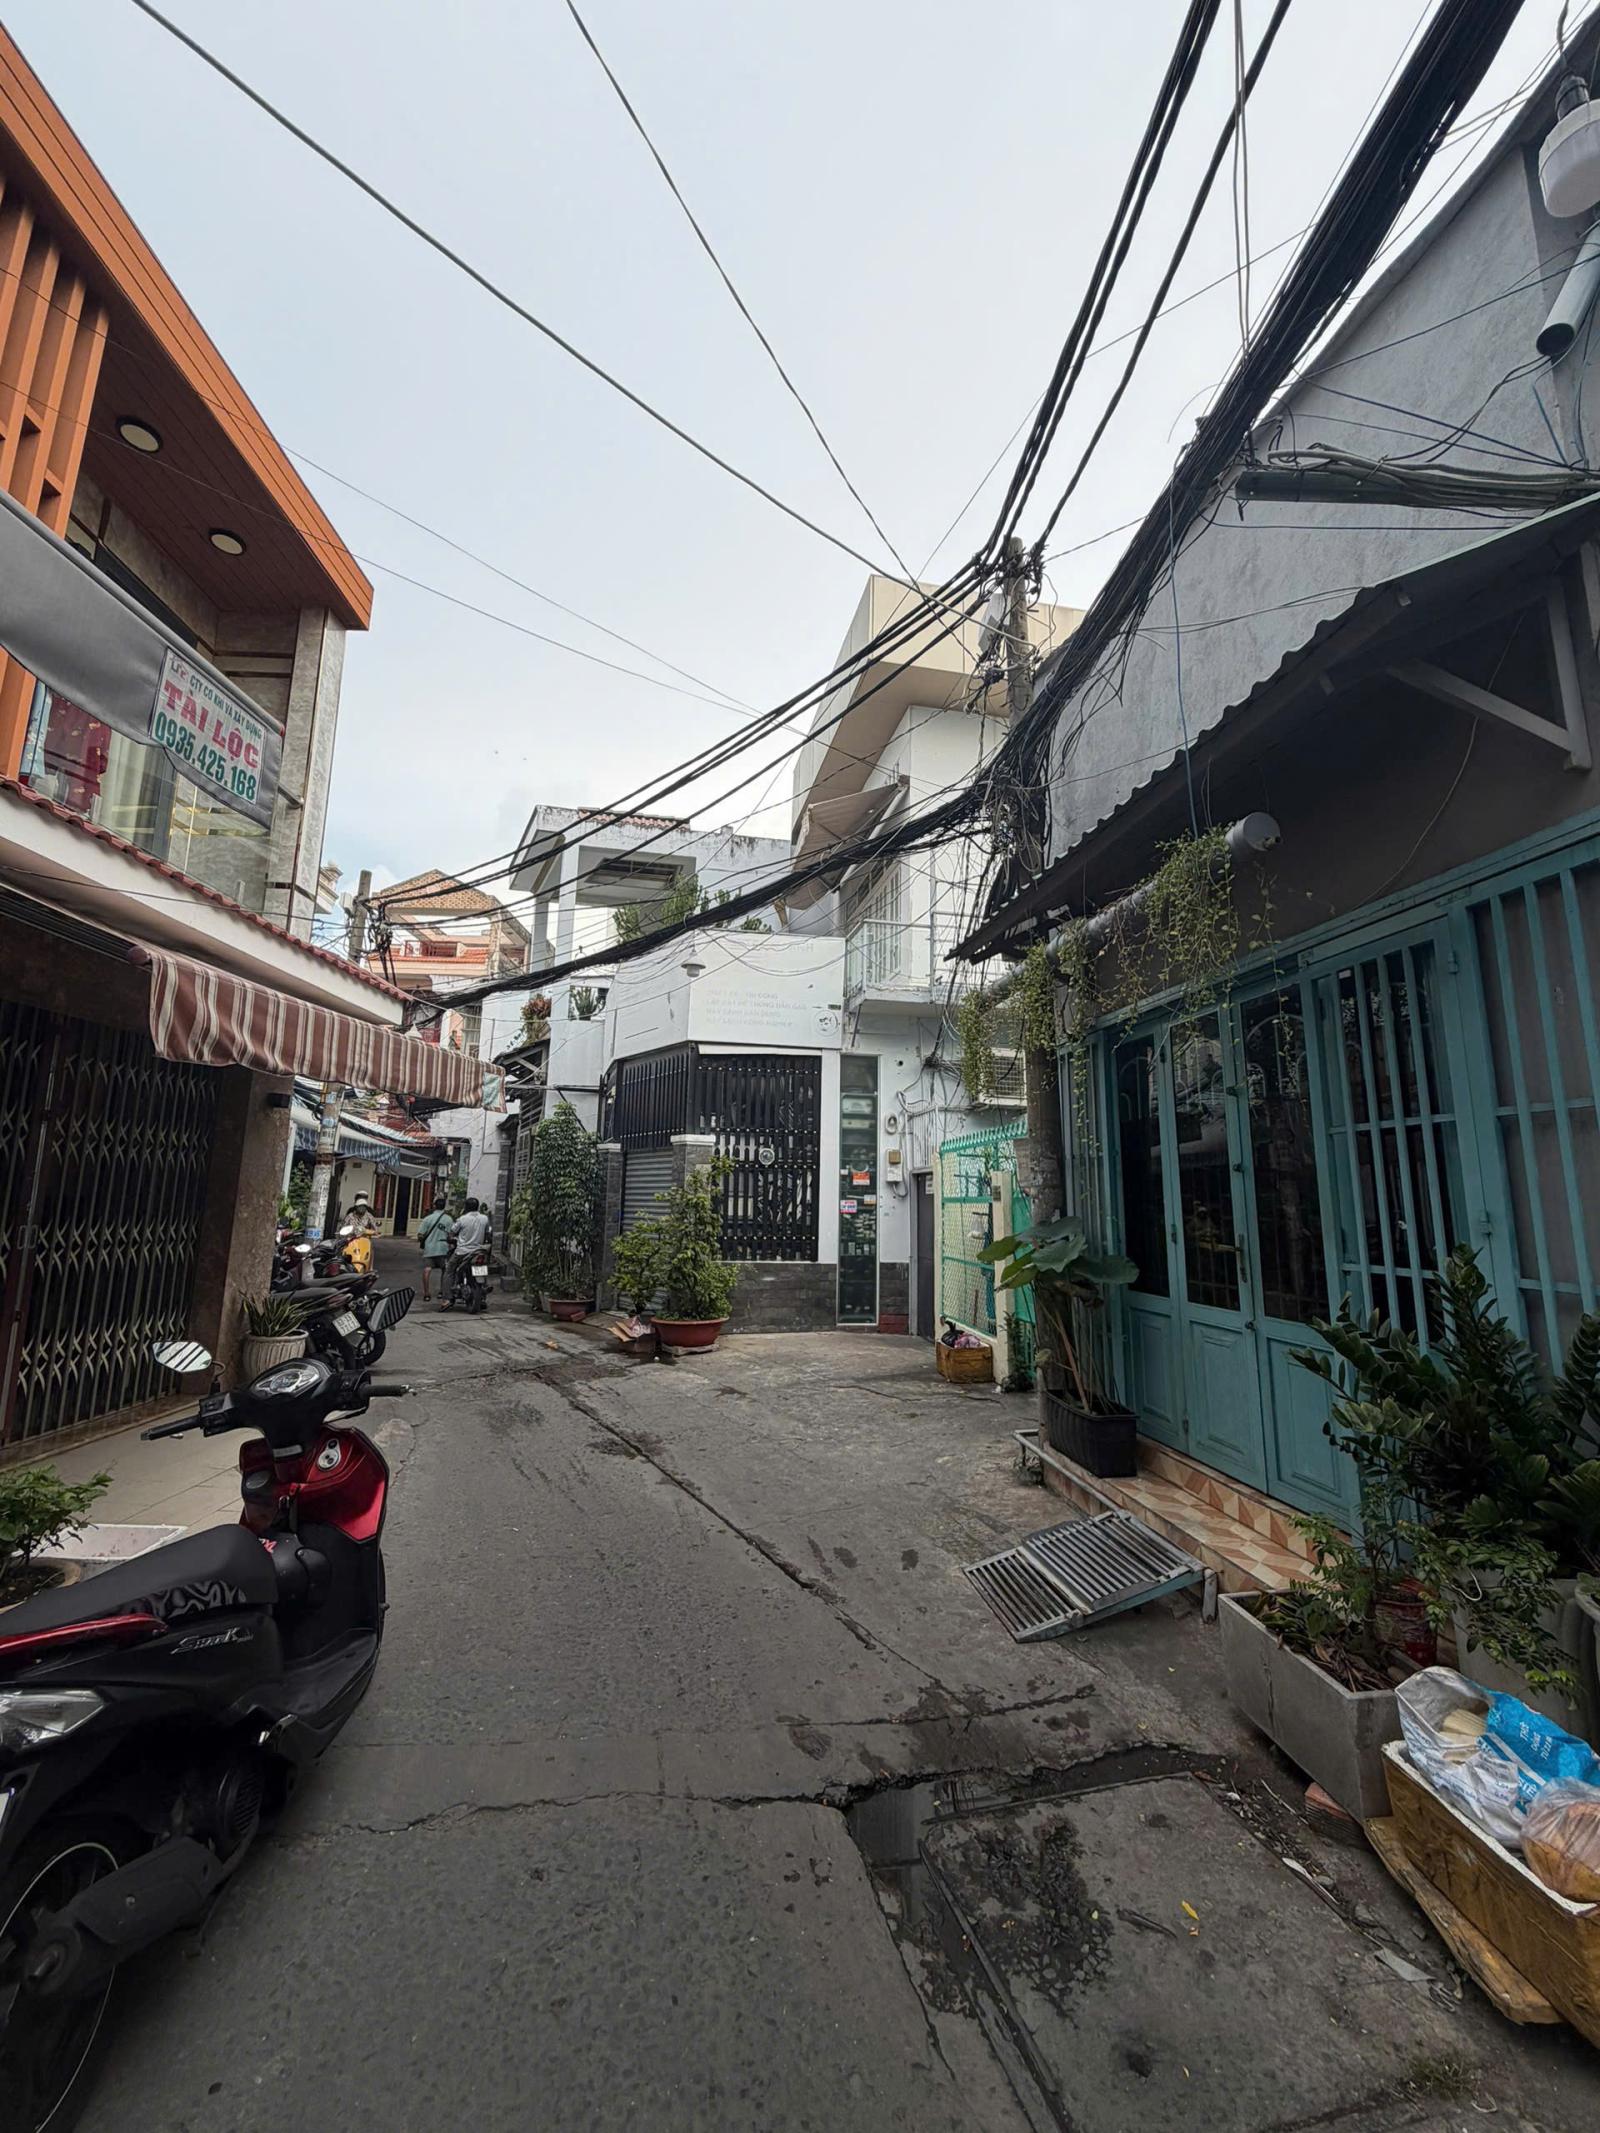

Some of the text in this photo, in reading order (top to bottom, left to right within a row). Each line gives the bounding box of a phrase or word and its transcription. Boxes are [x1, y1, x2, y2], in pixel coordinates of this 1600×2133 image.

[164, 679, 259, 769] TÀI LỘC
[190, 675, 203, 692] CTY
[155, 711, 257, 801] 0935.425.168
